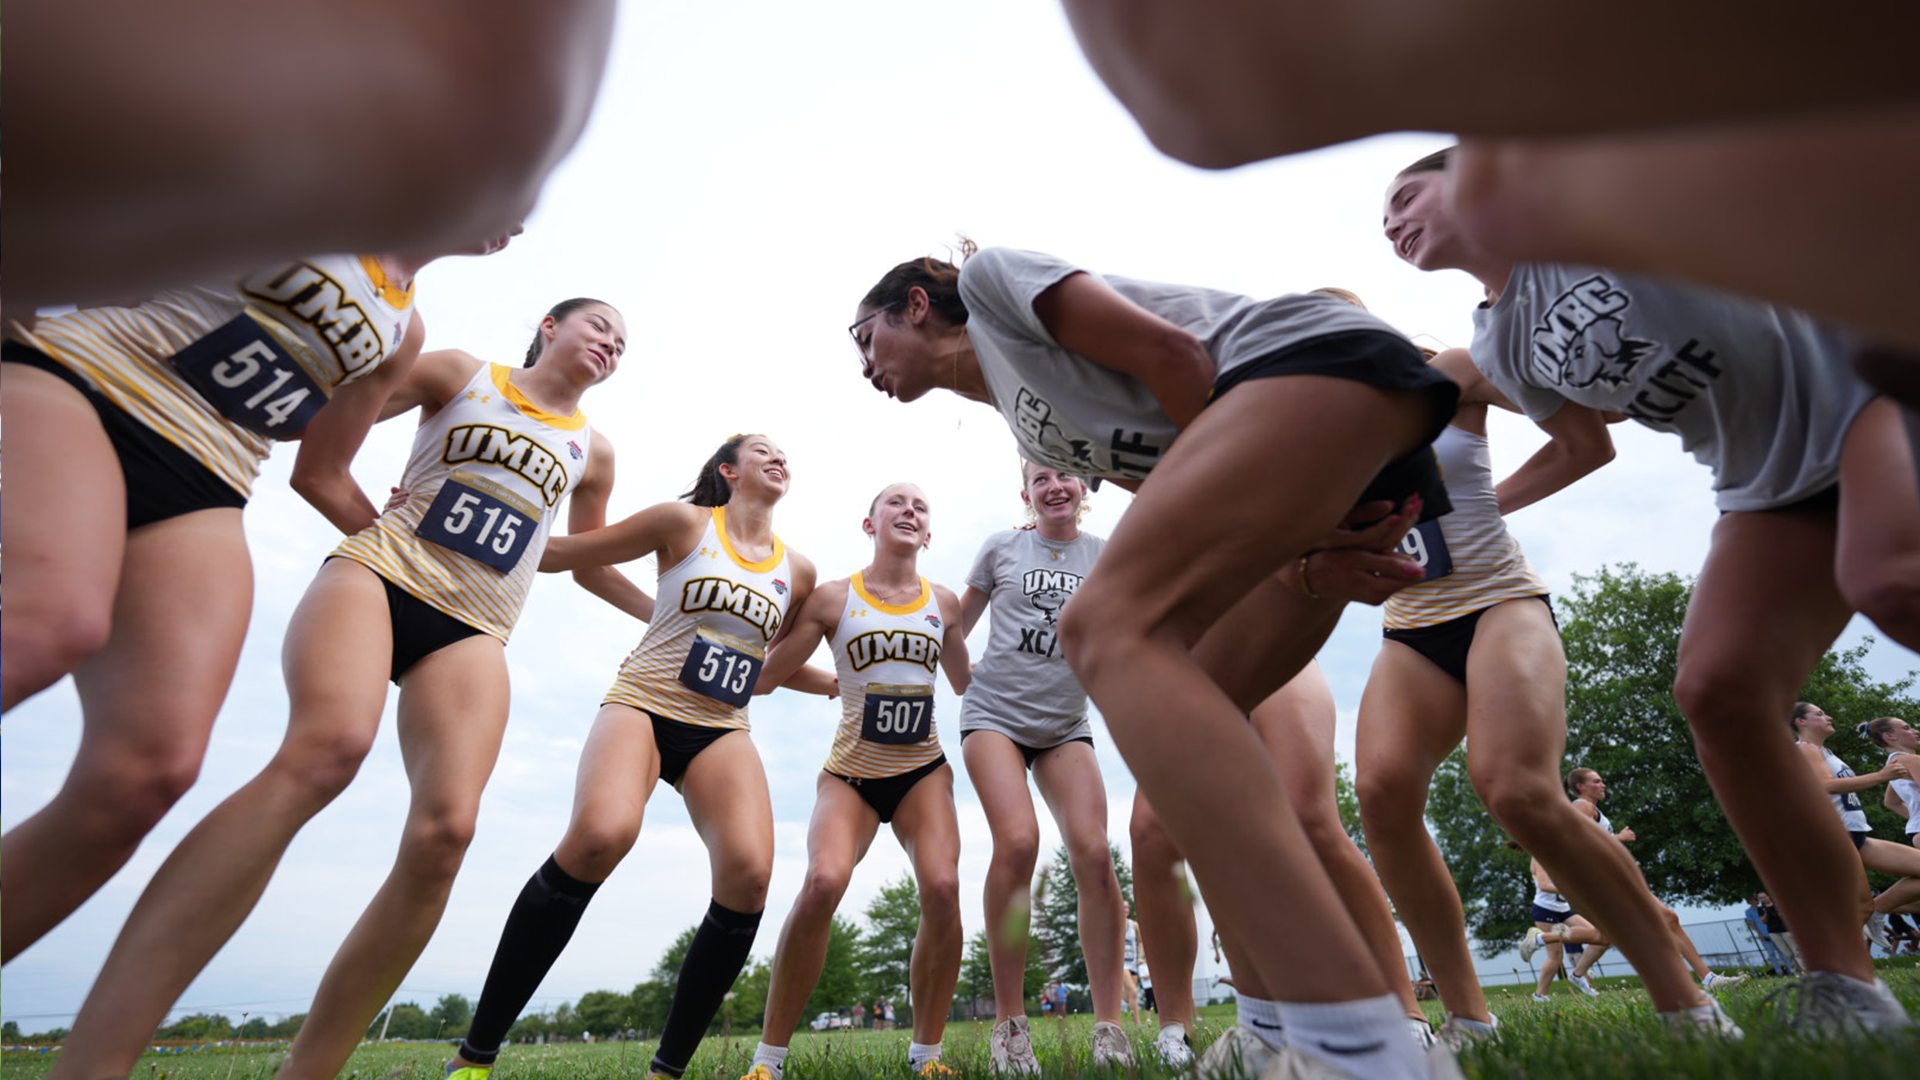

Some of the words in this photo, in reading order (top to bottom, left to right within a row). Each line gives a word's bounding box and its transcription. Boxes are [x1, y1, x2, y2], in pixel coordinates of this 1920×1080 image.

[1532, 274, 1630, 386] UMBC
[211, 339, 312, 428] 514
[1014, 387, 1052, 445] BC
[443, 424, 568, 508] UMBC
[443, 492, 523, 555] 515
[680, 577, 782, 643] UMBC
[1023, 568, 1086, 596] UMB
[698, 645, 752, 694] 513
[847, 630, 943, 674] UMBC
[876, 701, 925, 734] 507
